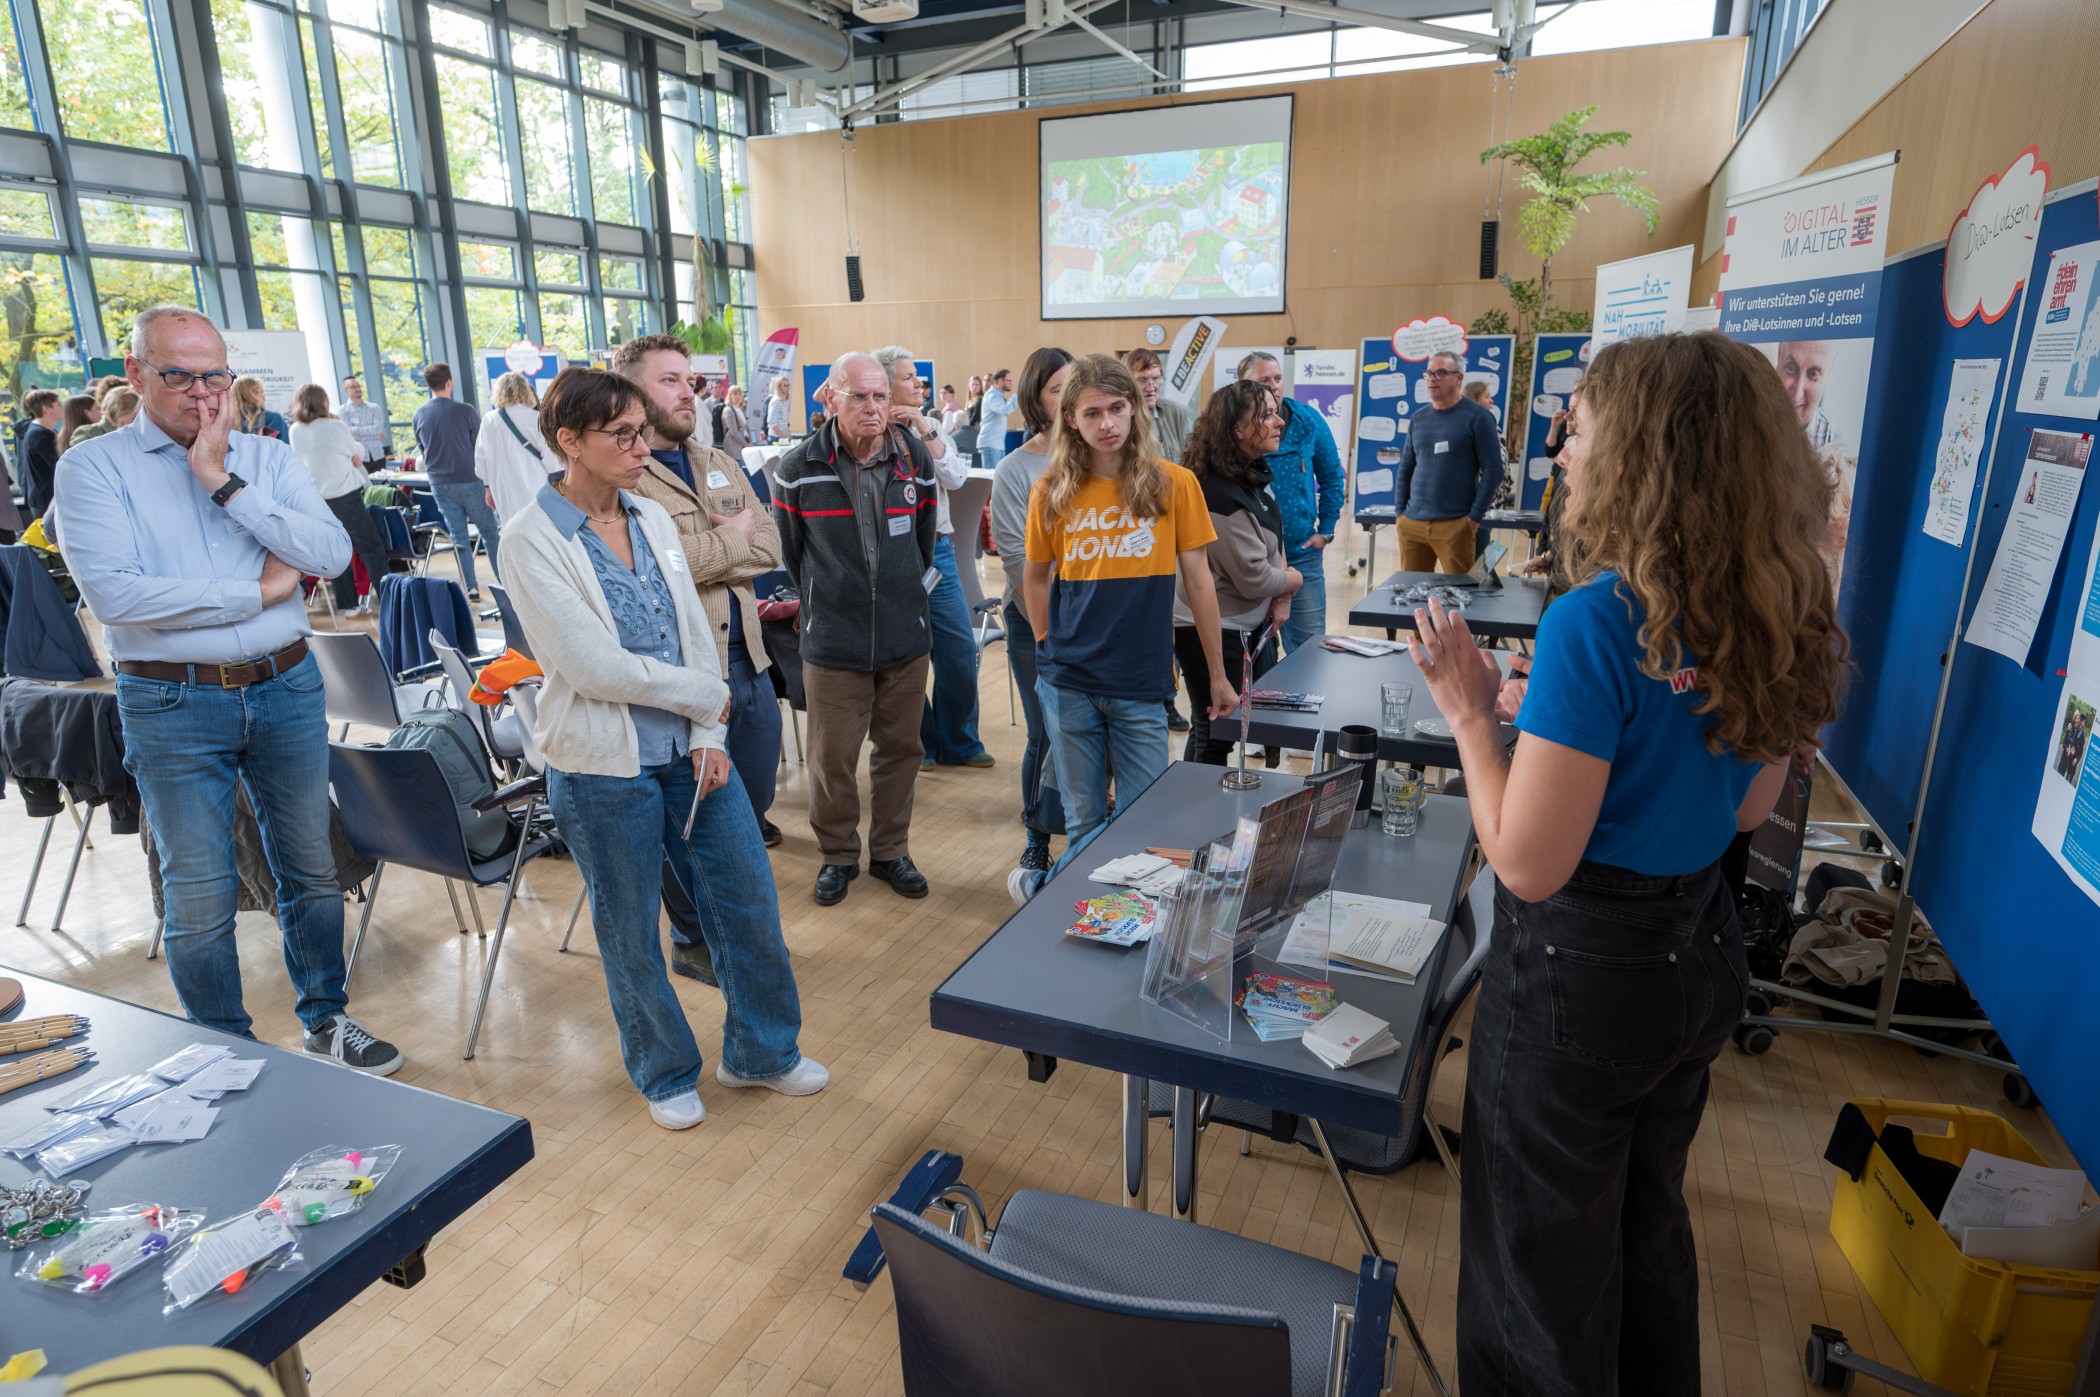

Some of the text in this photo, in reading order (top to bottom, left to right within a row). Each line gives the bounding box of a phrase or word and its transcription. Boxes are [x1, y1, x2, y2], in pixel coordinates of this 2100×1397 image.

[1781, 228, 1847, 259] IM ALTER
[2053, 278, 2077, 295] ehren
[1729, 283, 1865, 312] Wir unterstützen Sie gerne!
[2049, 294, 2067, 309] amt
[1604, 309, 1624, 325] NAH
[1618, 316, 1665, 337] MOBILITÄT
[1725, 312, 1862, 333] Ihre Di@-Lotsinnen und -Lotsen
[1173, 324, 1210, 387] #BEACTIVE
[1768, 811, 1797, 833] essen
[1749, 844, 1793, 879] esregierung
